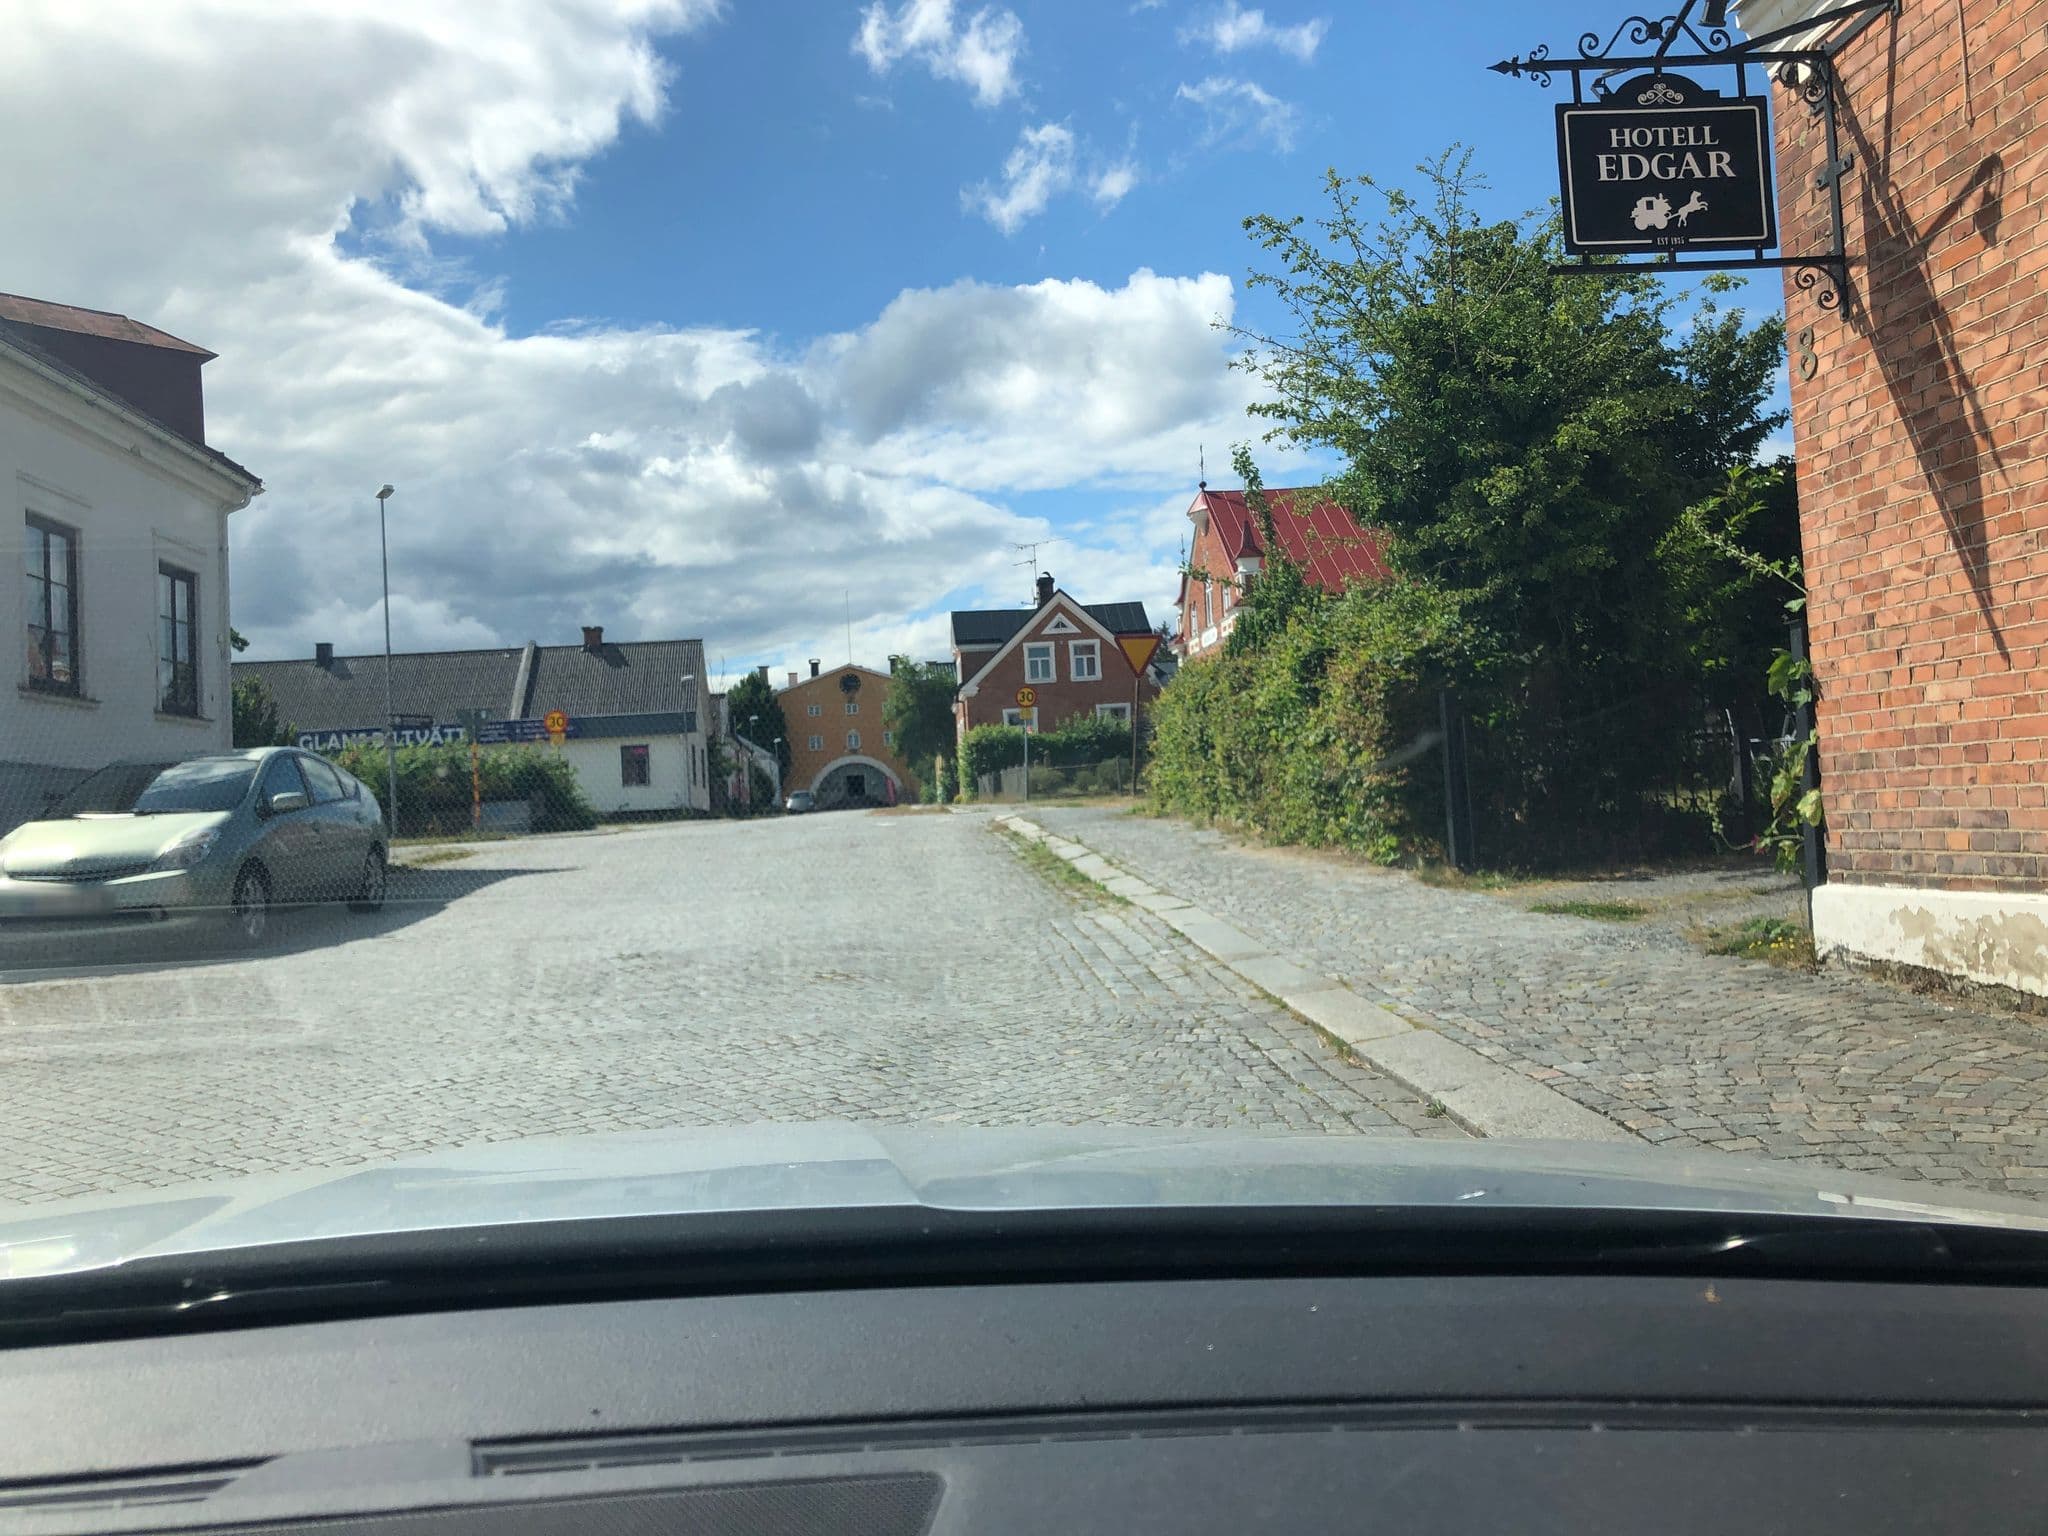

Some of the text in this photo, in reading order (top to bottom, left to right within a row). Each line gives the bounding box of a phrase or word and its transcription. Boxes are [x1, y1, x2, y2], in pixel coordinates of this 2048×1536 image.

[1610, 126, 1720, 148] HOTELL
[1597, 151, 1736, 182] EDGAR
[1657, 237, 1669, 246] EST
[1797, 325, 1816, 381] 8
[1019, 691, 1034, 702] 30
[549, 716, 565, 728] 30
